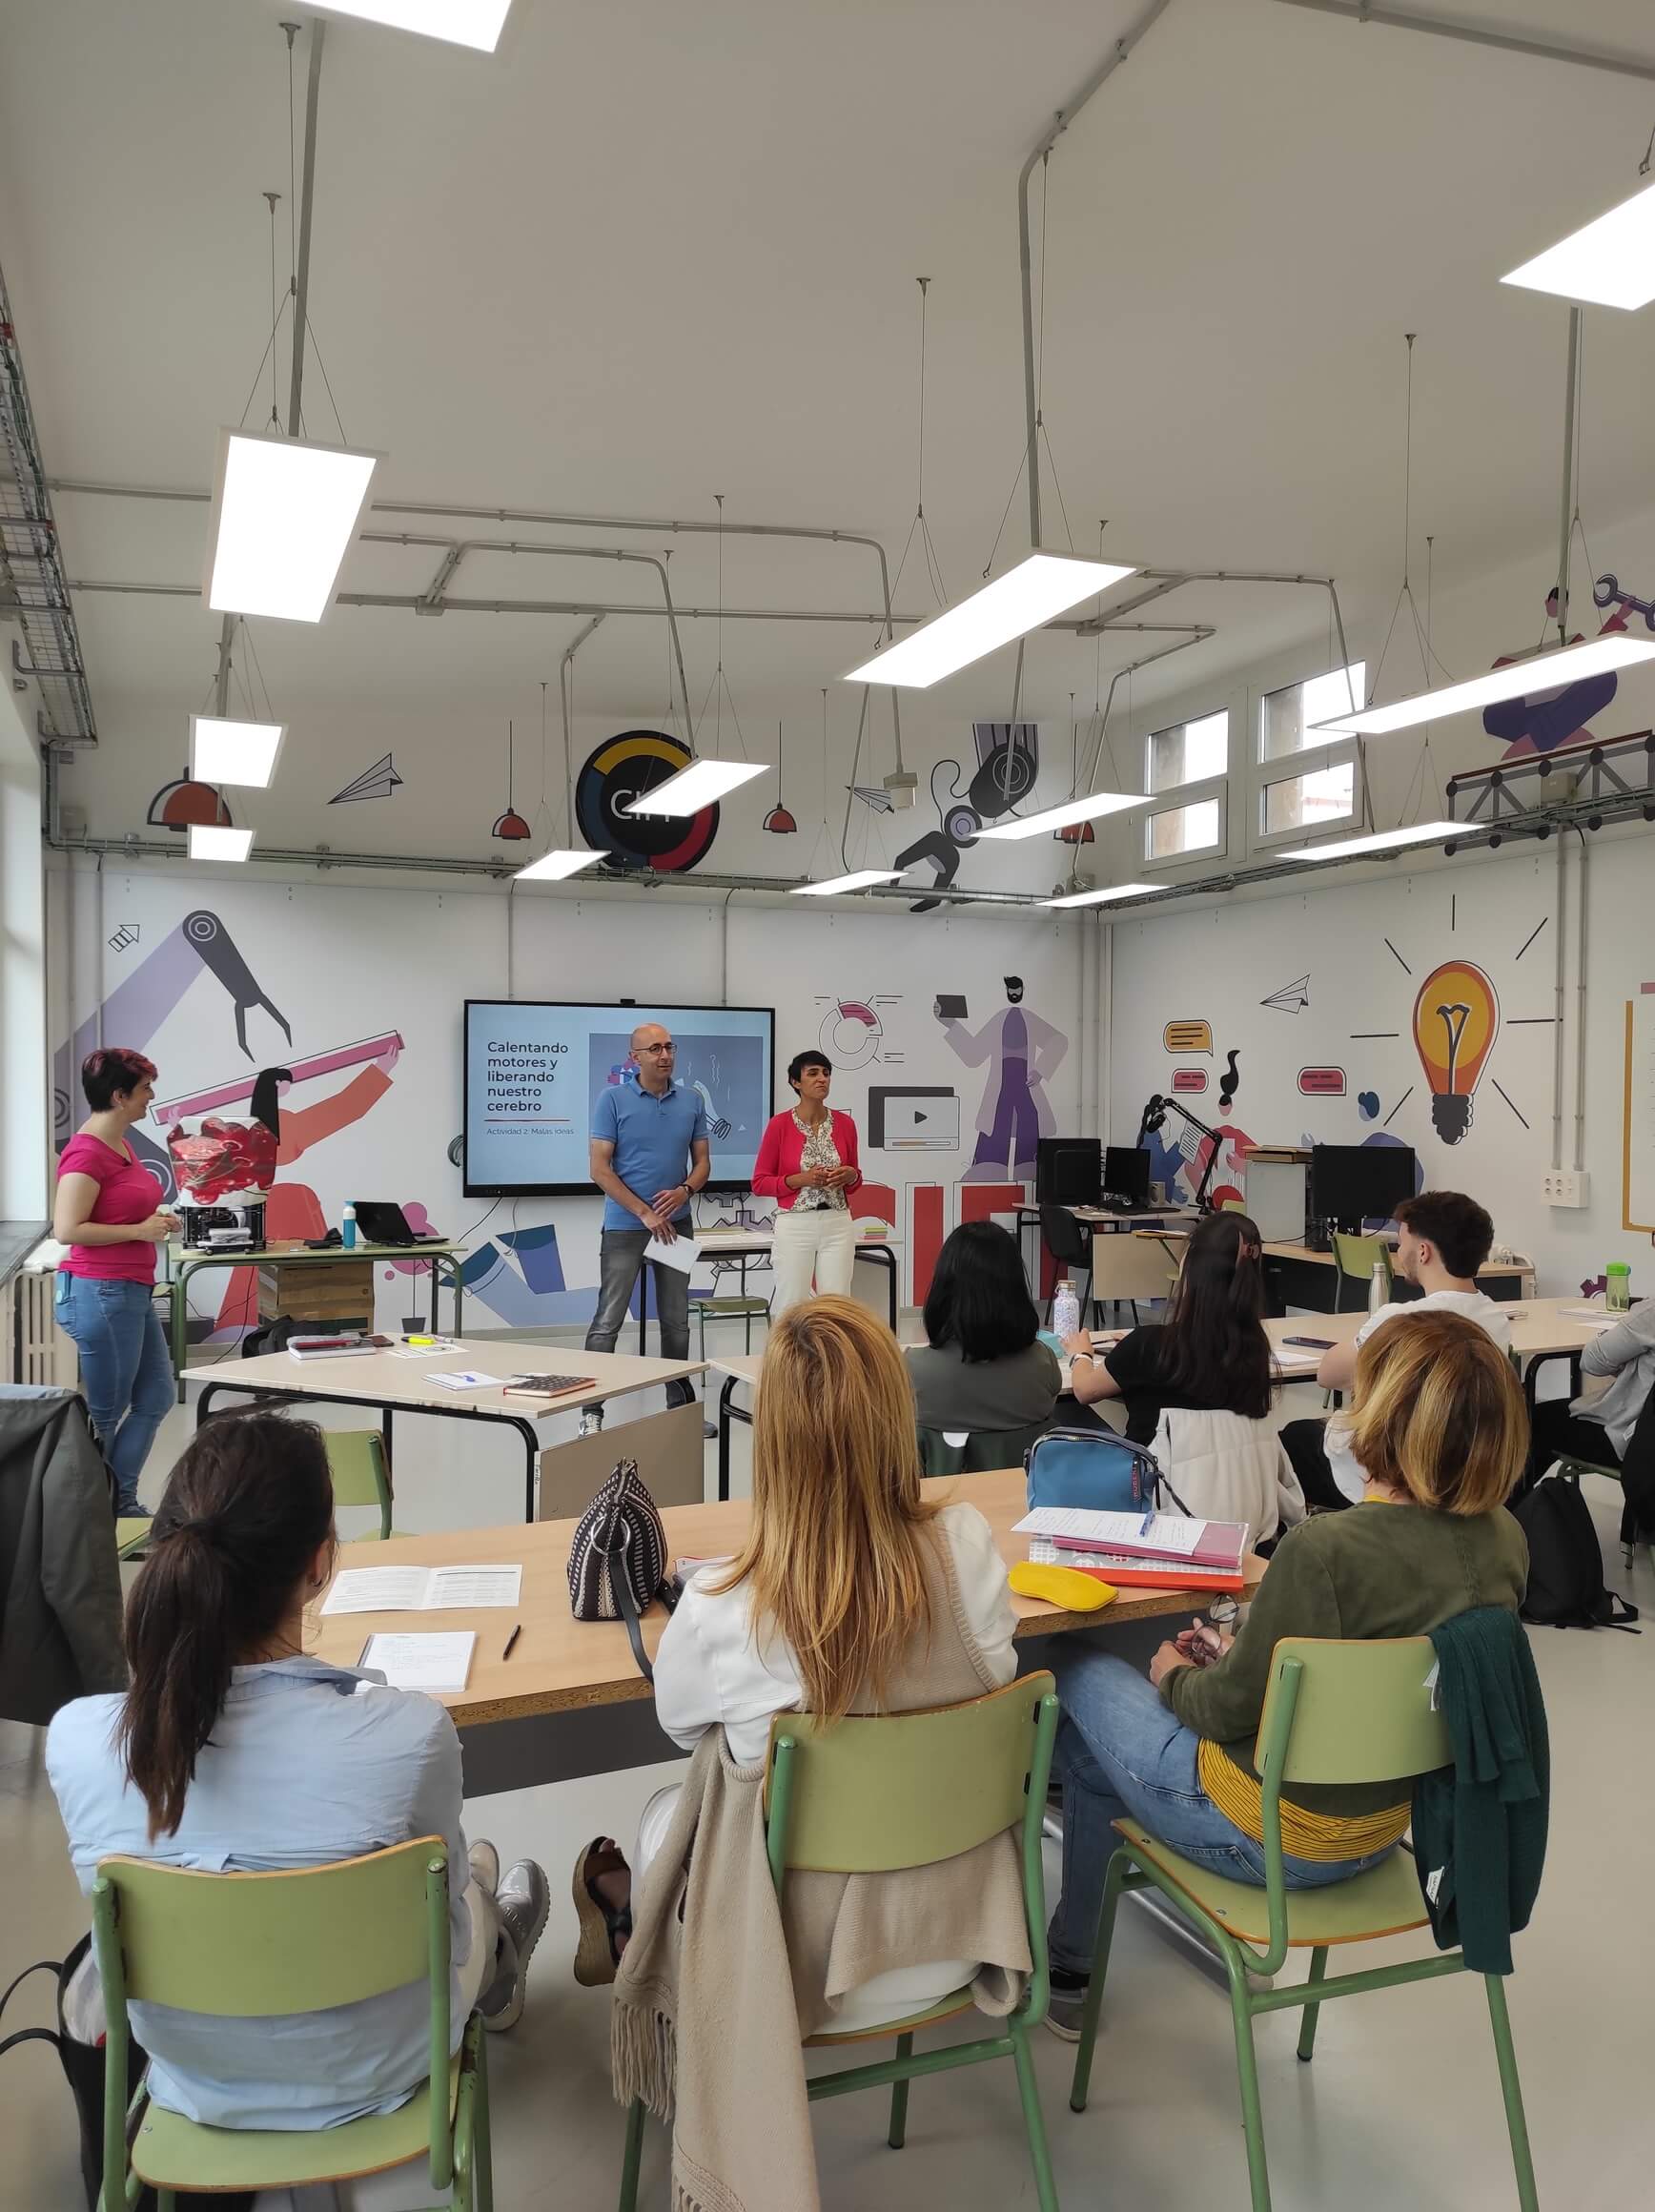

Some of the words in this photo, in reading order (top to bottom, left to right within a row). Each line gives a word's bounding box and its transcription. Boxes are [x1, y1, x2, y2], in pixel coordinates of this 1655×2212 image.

[487, 1041, 569, 1054] Calentando
[487, 1057, 547, 1068] motores
[549, 1059, 559, 1071] y
[487, 1070, 555, 1082] liberando
[487, 1087, 542, 1097] nuestro
[487, 1100, 542, 1112] cerebro
